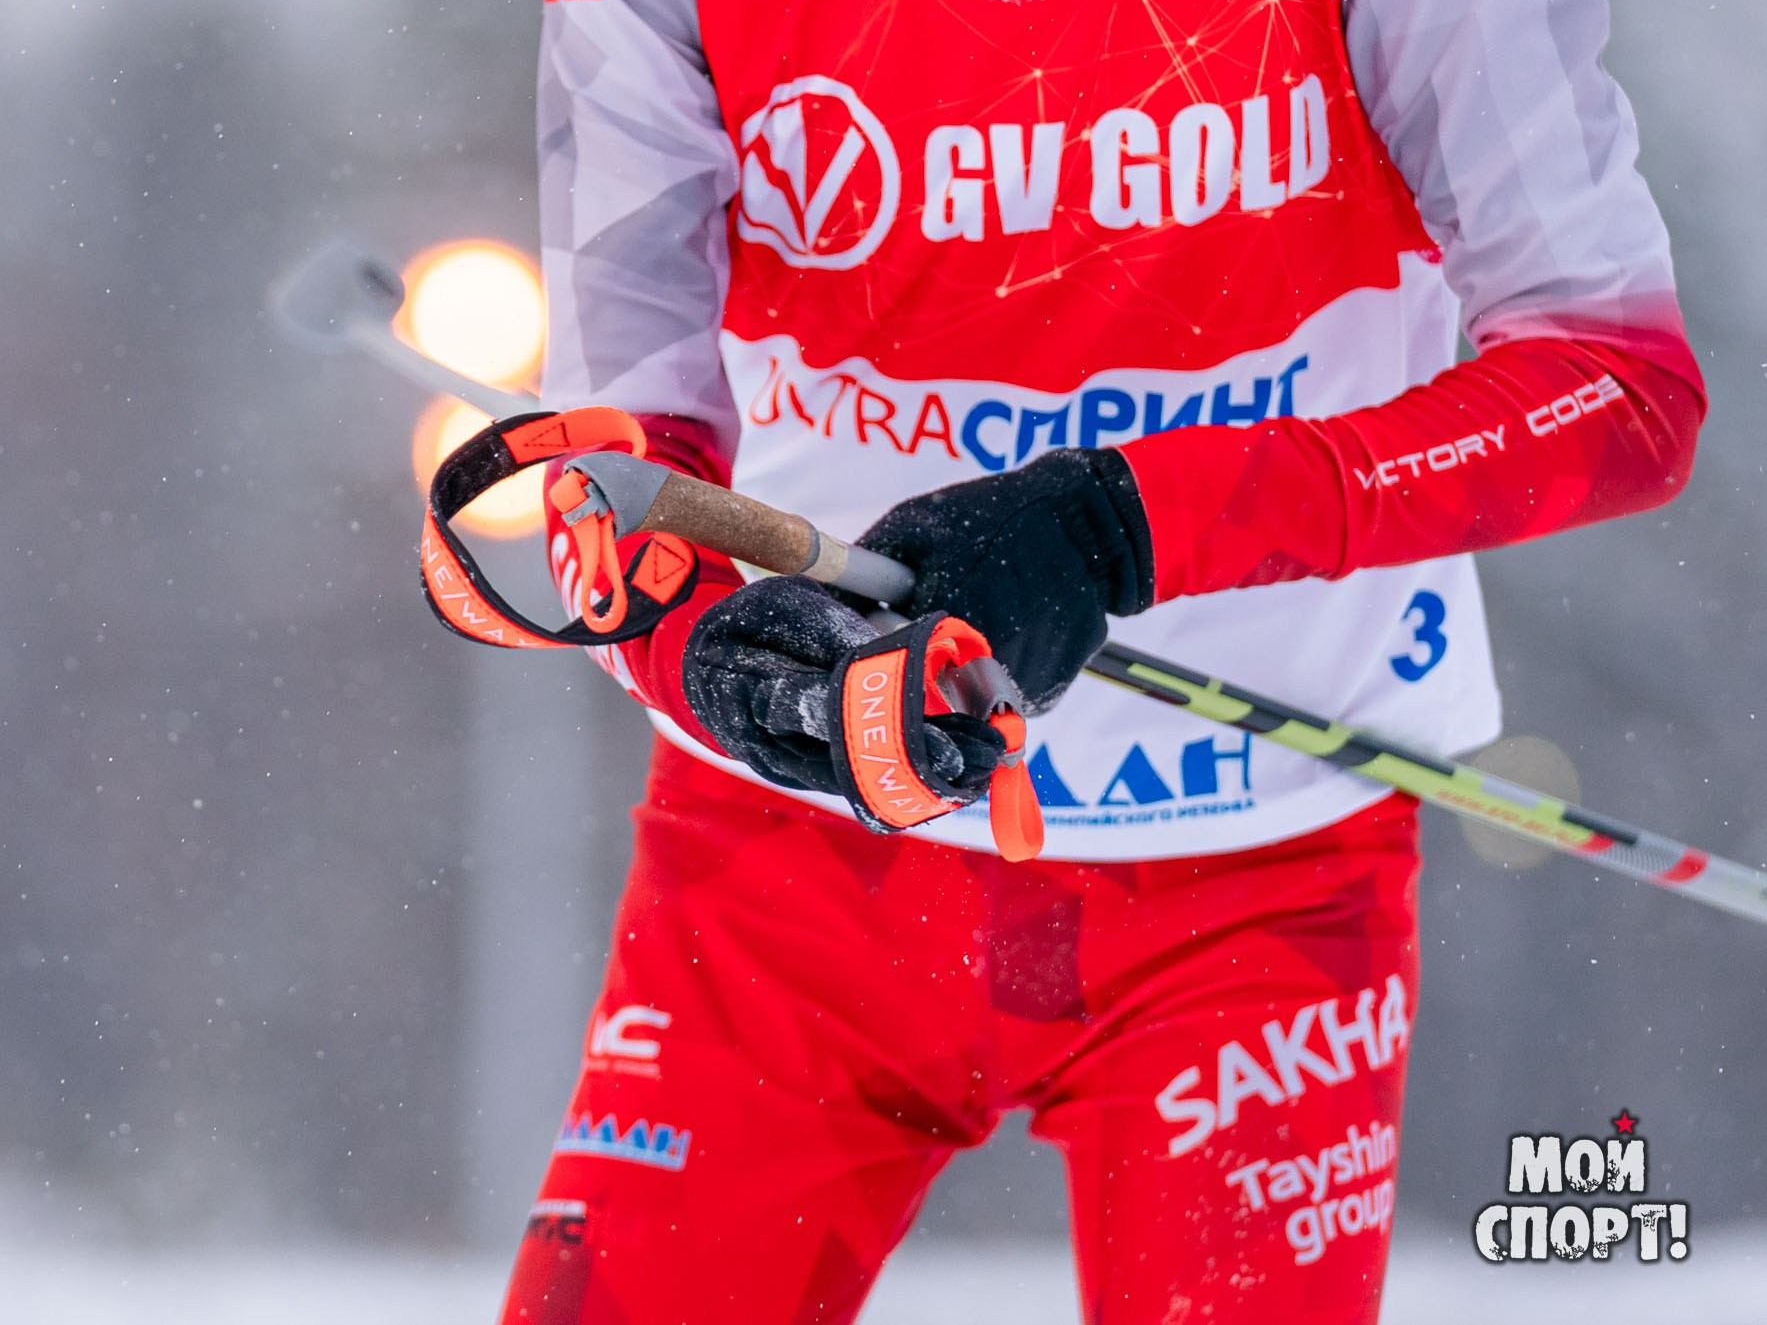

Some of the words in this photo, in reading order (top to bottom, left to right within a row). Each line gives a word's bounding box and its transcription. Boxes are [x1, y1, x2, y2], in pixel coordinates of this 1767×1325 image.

[920, 121, 1066, 243] GV
[1089, 73, 1332, 230] GOLD
[1388, 588, 1447, 682] 3
[859, 671, 927, 814] ONE/WAY
[1155, 974, 1408, 1159] SAKHA
[1225, 1120, 1396, 1212] Tayshin
[1285, 1178, 1394, 1266] group
